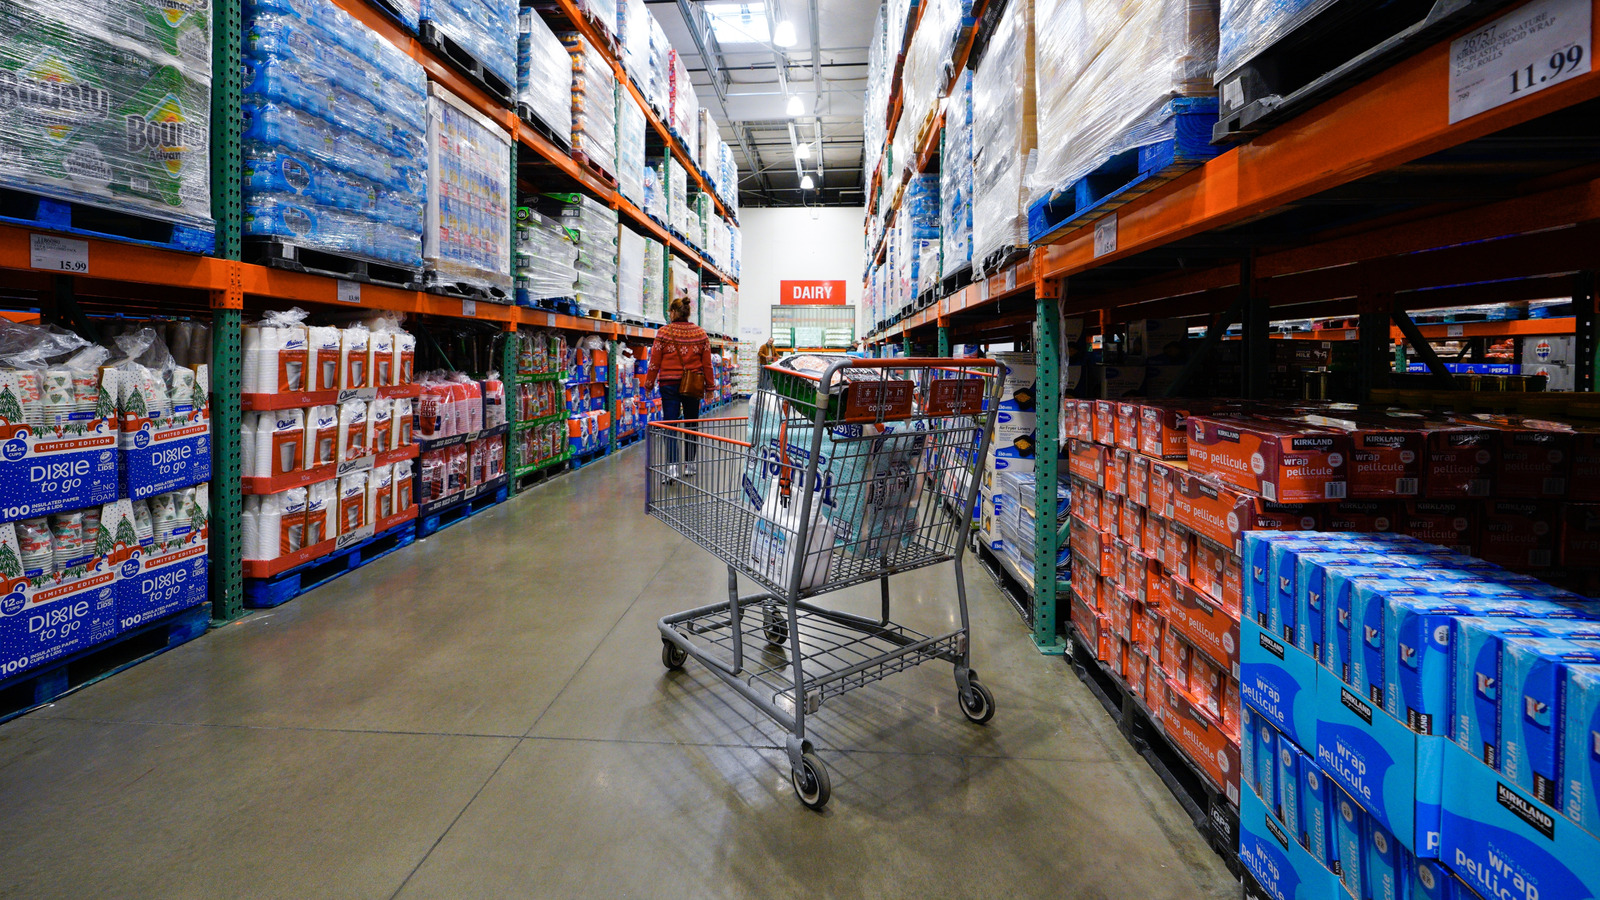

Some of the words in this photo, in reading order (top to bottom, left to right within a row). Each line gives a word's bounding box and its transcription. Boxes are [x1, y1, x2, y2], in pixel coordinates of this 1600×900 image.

[1456, 37, 1496, 60] KIRKLAND
[1498, 12, 1548, 40] SIGNATURE
[1462, 25, 1496, 51] 26757
[1469, 44, 1501, 63] PLASTIC
[1502, 31, 1527, 48] FOOD
[1529, 17, 1555, 34] WRAP
[1478, 51, 1503, 66] ROLLS
[1509, 44, 1584, 95] 11.99
[60, 260, 87, 272] 15.99
[793, 286, 833, 299] DAIRY
[157, 430, 181, 439] LIMITED
[182, 426, 205, 435] EDITION
[1217, 430, 1239, 440] KIRKLAND
[1366, 435, 1405, 443] KIRKLAND
[40, 443, 75, 451] LIMITED
[79, 438, 110, 447] EDITION
[1293, 438, 1333, 446] KIRKLAND
[1189, 447, 1207, 461] wrap
[1210, 452, 1248, 472] pellicule
[1283, 458, 1309, 467] wrap
[1355, 453, 1381, 462] wrap
[159, 464, 171, 474] to
[173, 461, 187, 475] go
[1286, 466, 1333, 478] pellicule
[1357, 463, 1404, 473] pellicule
[193, 472, 209, 481] FOAM
[41, 481, 58, 493] to
[61, 478, 82, 493] go
[102, 483, 115, 491] NO
[135, 484, 154, 497] 100
[31, 500, 62, 508] INSULATED
[62, 496, 80, 504] PAPER
[91, 492, 116, 503] FOAM
[1265, 501, 1303, 509] KIRKLAND
[2, 505, 30, 519] 100
[31, 506, 46, 514] CUPS
[1176, 499, 1190, 513] wrap
[1193, 507, 1225, 529] pellicule
[1257, 518, 1282, 528] wrap
[149, 555, 176, 566] LIMITED
[178, 547, 203, 558] EDITION
[38, 586, 74, 600] LIMITED
[77, 575, 110, 588] EDITION
[150, 591, 163, 602] to
[165, 585, 181, 600] go
[196, 585, 205, 593] NO
[186, 593, 206, 605] FOAM
[102, 618, 114, 628] NO
[120, 614, 142, 629] 100
[1171, 604, 1187, 621] wrap
[1189, 616, 1220, 646] pellicule
[40, 628, 56, 641] to
[60, 620, 80, 638] go
[90, 628, 115, 643] FOAM
[30, 645, 61, 659] INSULATED
[61, 639, 79, 648] PAPER
[1260, 634, 1284, 653] KIRKLAND
[29, 655, 45, 664] CUPS
[50, 649, 62, 657] LIDS
[0, 656, 29, 675] 100
[1256, 677, 1280, 703] wrap
[1242, 682, 1284, 723] pellicule
[1342, 689, 1371, 715] KIRKLAND
[1166, 709, 1181, 729] wrap
[1183, 725, 1215, 762] pellicule
[1336, 741, 1366, 775] wrap
[1504, 741, 1517, 779] wrap
[1318, 744, 1371, 800] pellicule
[1499, 785, 1552, 828] KIRKLAND
[1568, 780, 1581, 822] wrap
[1256, 843, 1280, 881] wrap
[1488, 842, 1515, 867] PLASTIC
[1516, 865, 1539, 885] FOOD
[1241, 843, 1285, 900] pellicule
[1488, 850, 1539, 900] wrap
